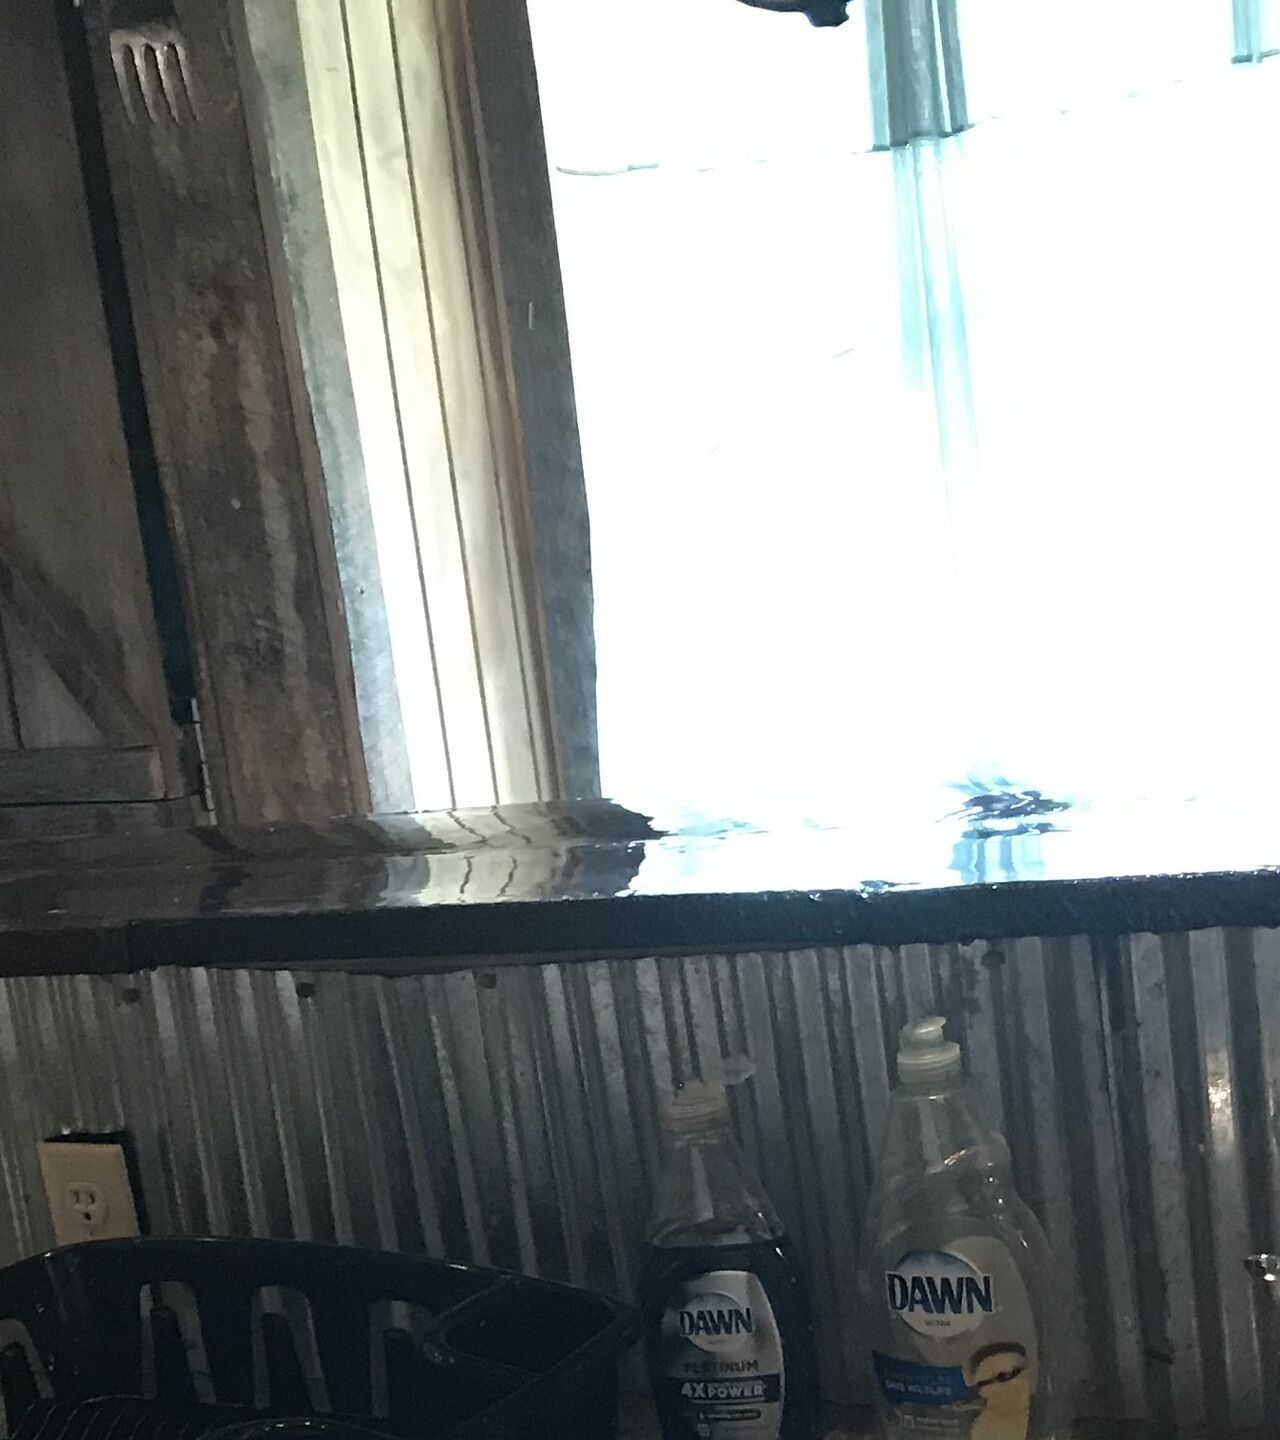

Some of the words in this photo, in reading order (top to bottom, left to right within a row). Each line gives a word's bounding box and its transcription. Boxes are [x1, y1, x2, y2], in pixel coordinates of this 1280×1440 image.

[886, 1273, 993, 1315] DAWN
[679, 1307, 753, 1336] DAWN
[681, 1382, 707, 1399] 4X
[707, 1383, 764, 1399] POWER
